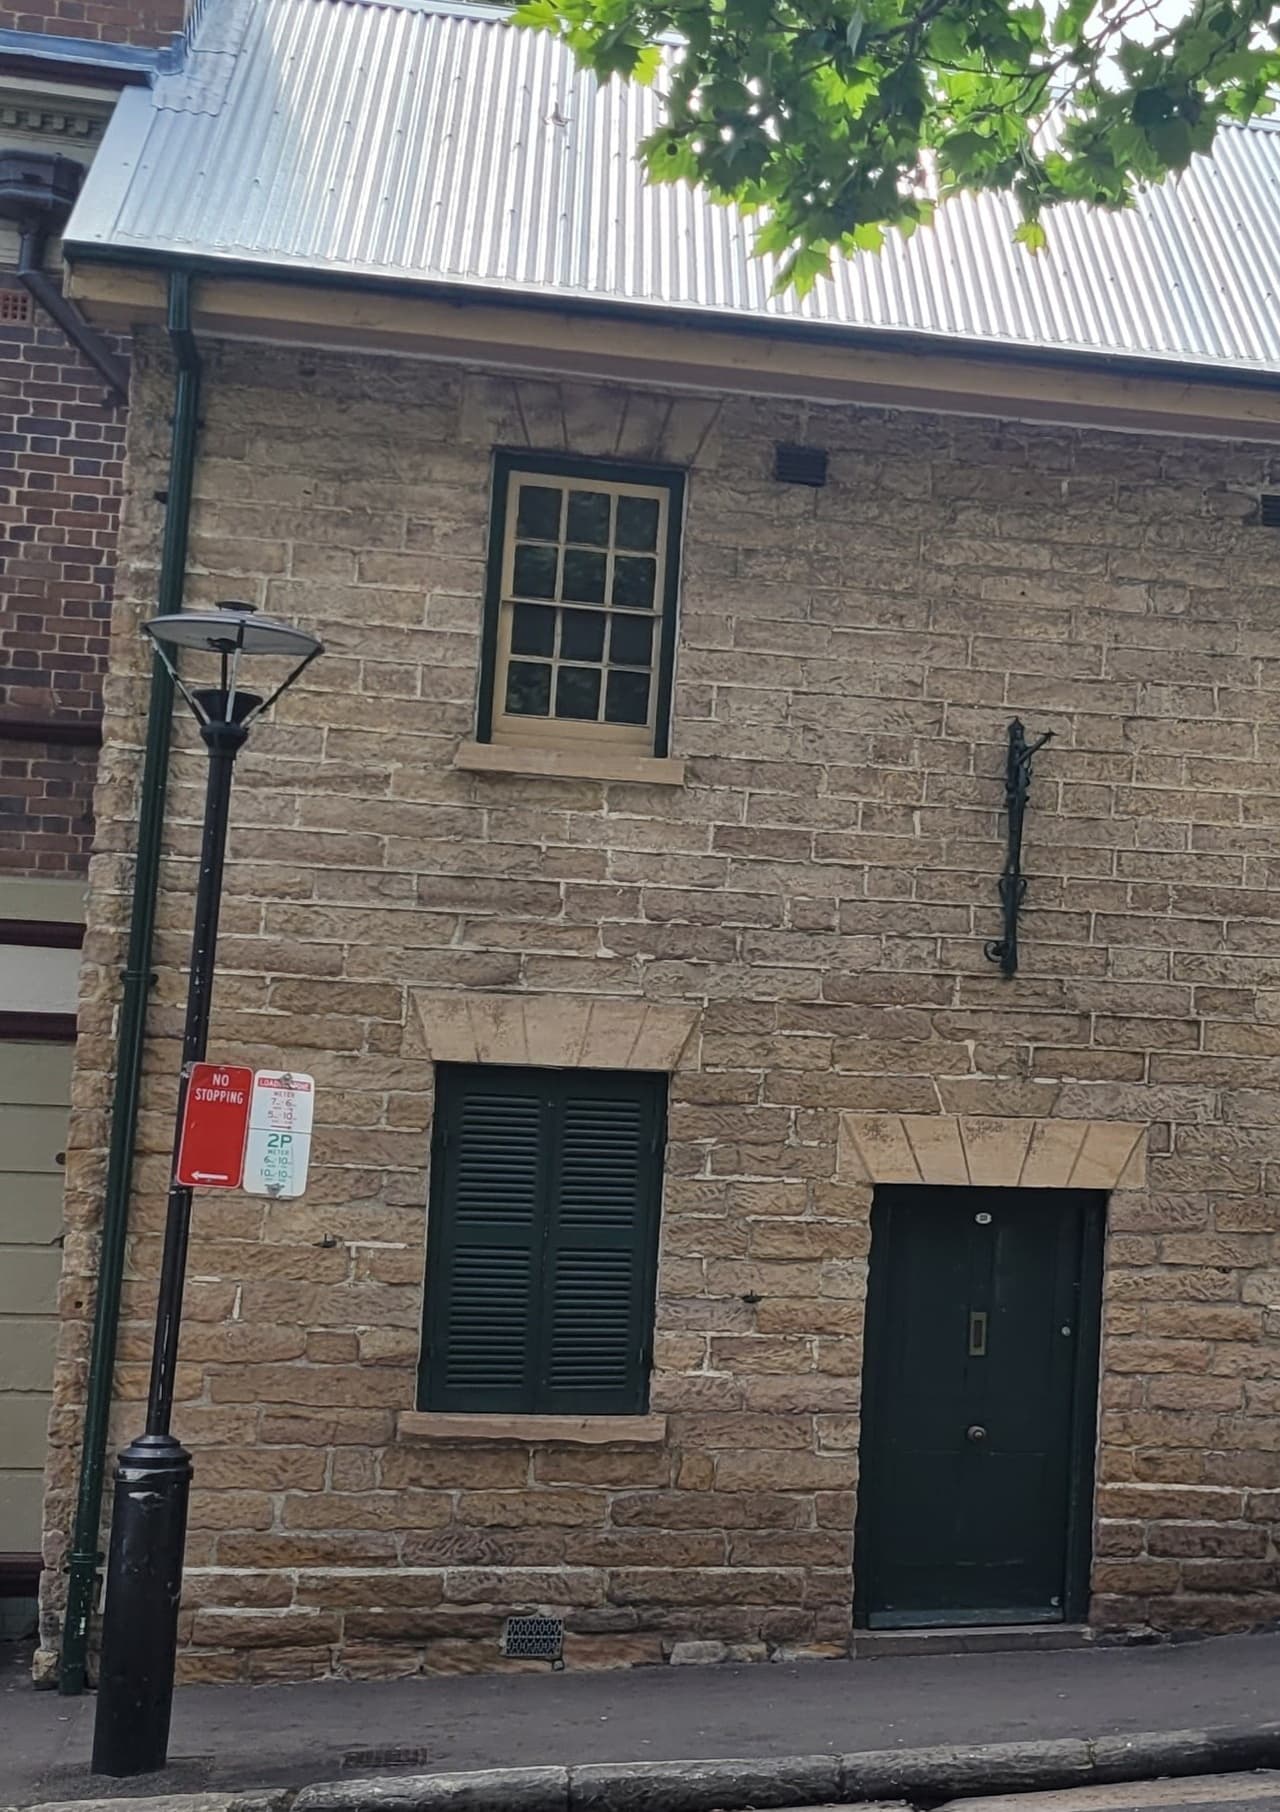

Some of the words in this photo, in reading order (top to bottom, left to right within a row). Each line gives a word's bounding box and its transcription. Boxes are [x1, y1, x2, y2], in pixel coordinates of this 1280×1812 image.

[212, 1073, 230, 1087] NO
[194, 1088, 244, 1105] STOPPING
[267, 1133, 293, 1149] 2P
